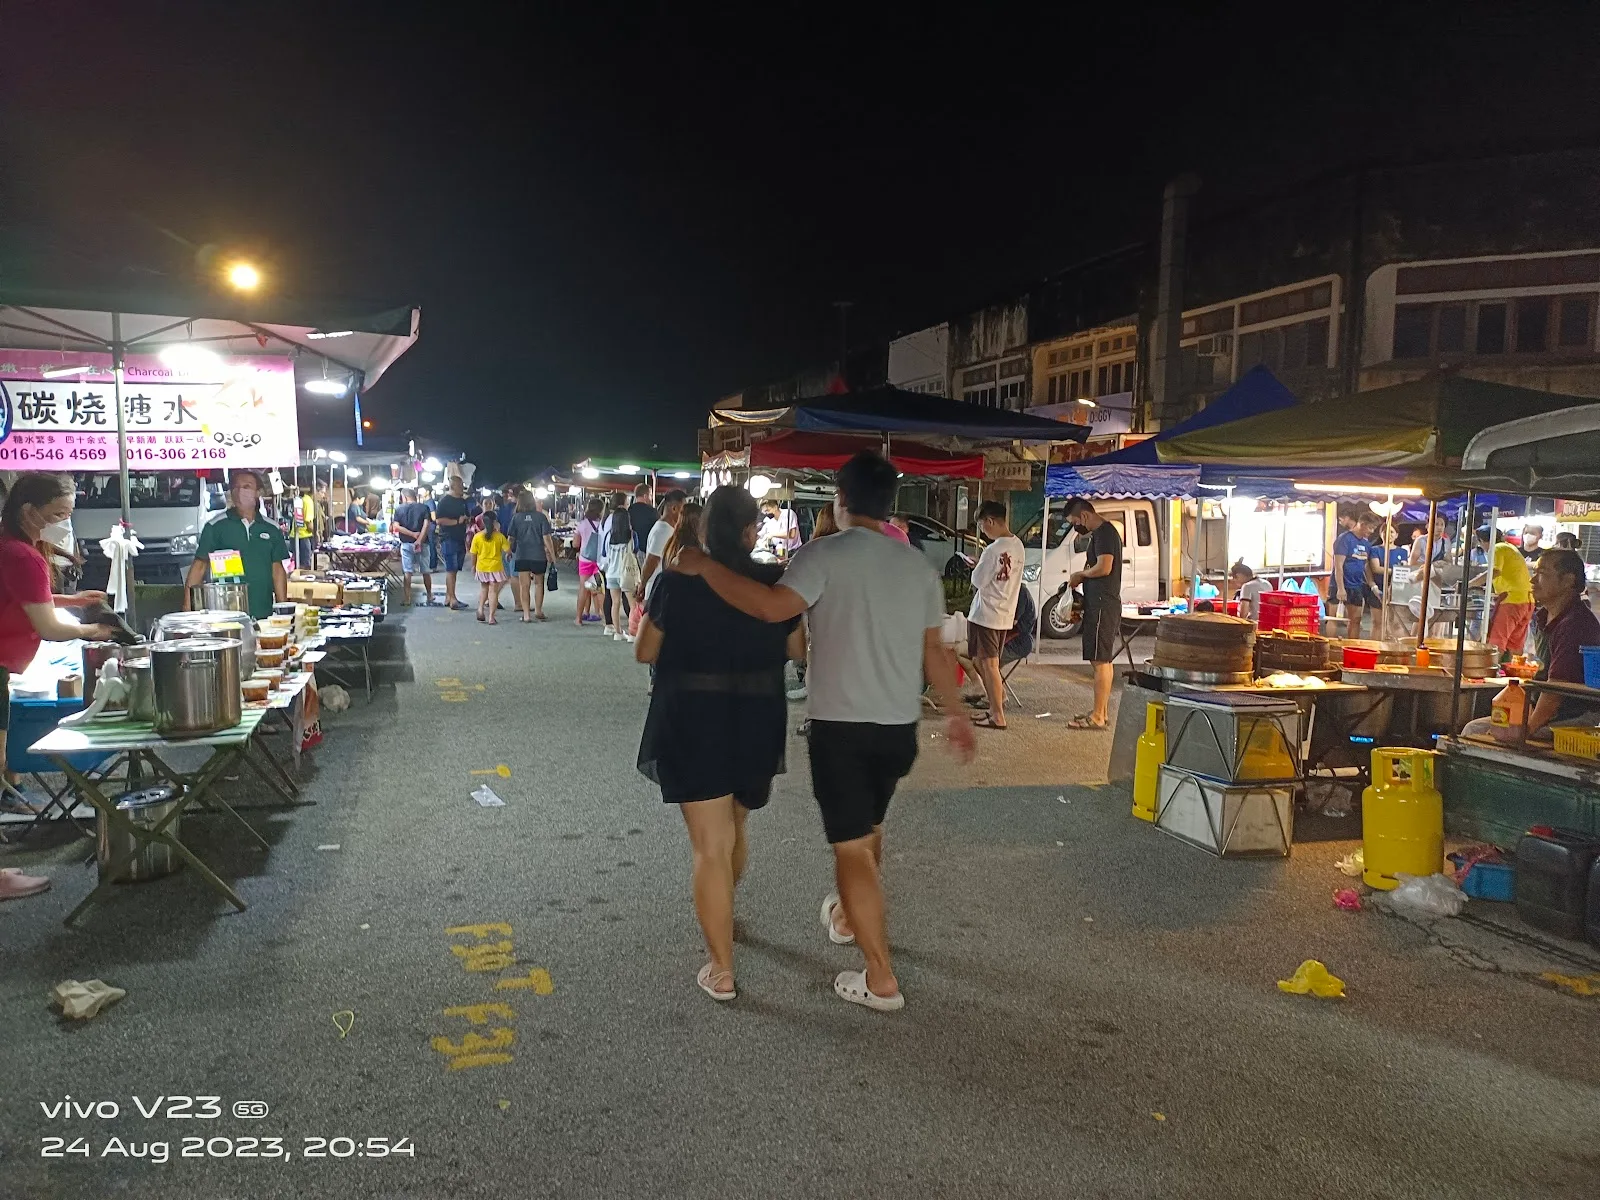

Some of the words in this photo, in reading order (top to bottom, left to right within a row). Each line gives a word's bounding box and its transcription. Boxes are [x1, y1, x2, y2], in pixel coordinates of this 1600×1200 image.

[127, 366, 173, 377] Charcoal
[16, 390, 198, 425] 碳烧糖水
[65, 435, 107, 445] 四十余式
[0, 447, 64, 460] 016-546
[69, 448, 107, 460] 4569
[126, 448, 186, 460] 016-306
[191, 447, 227, 459] 2168
